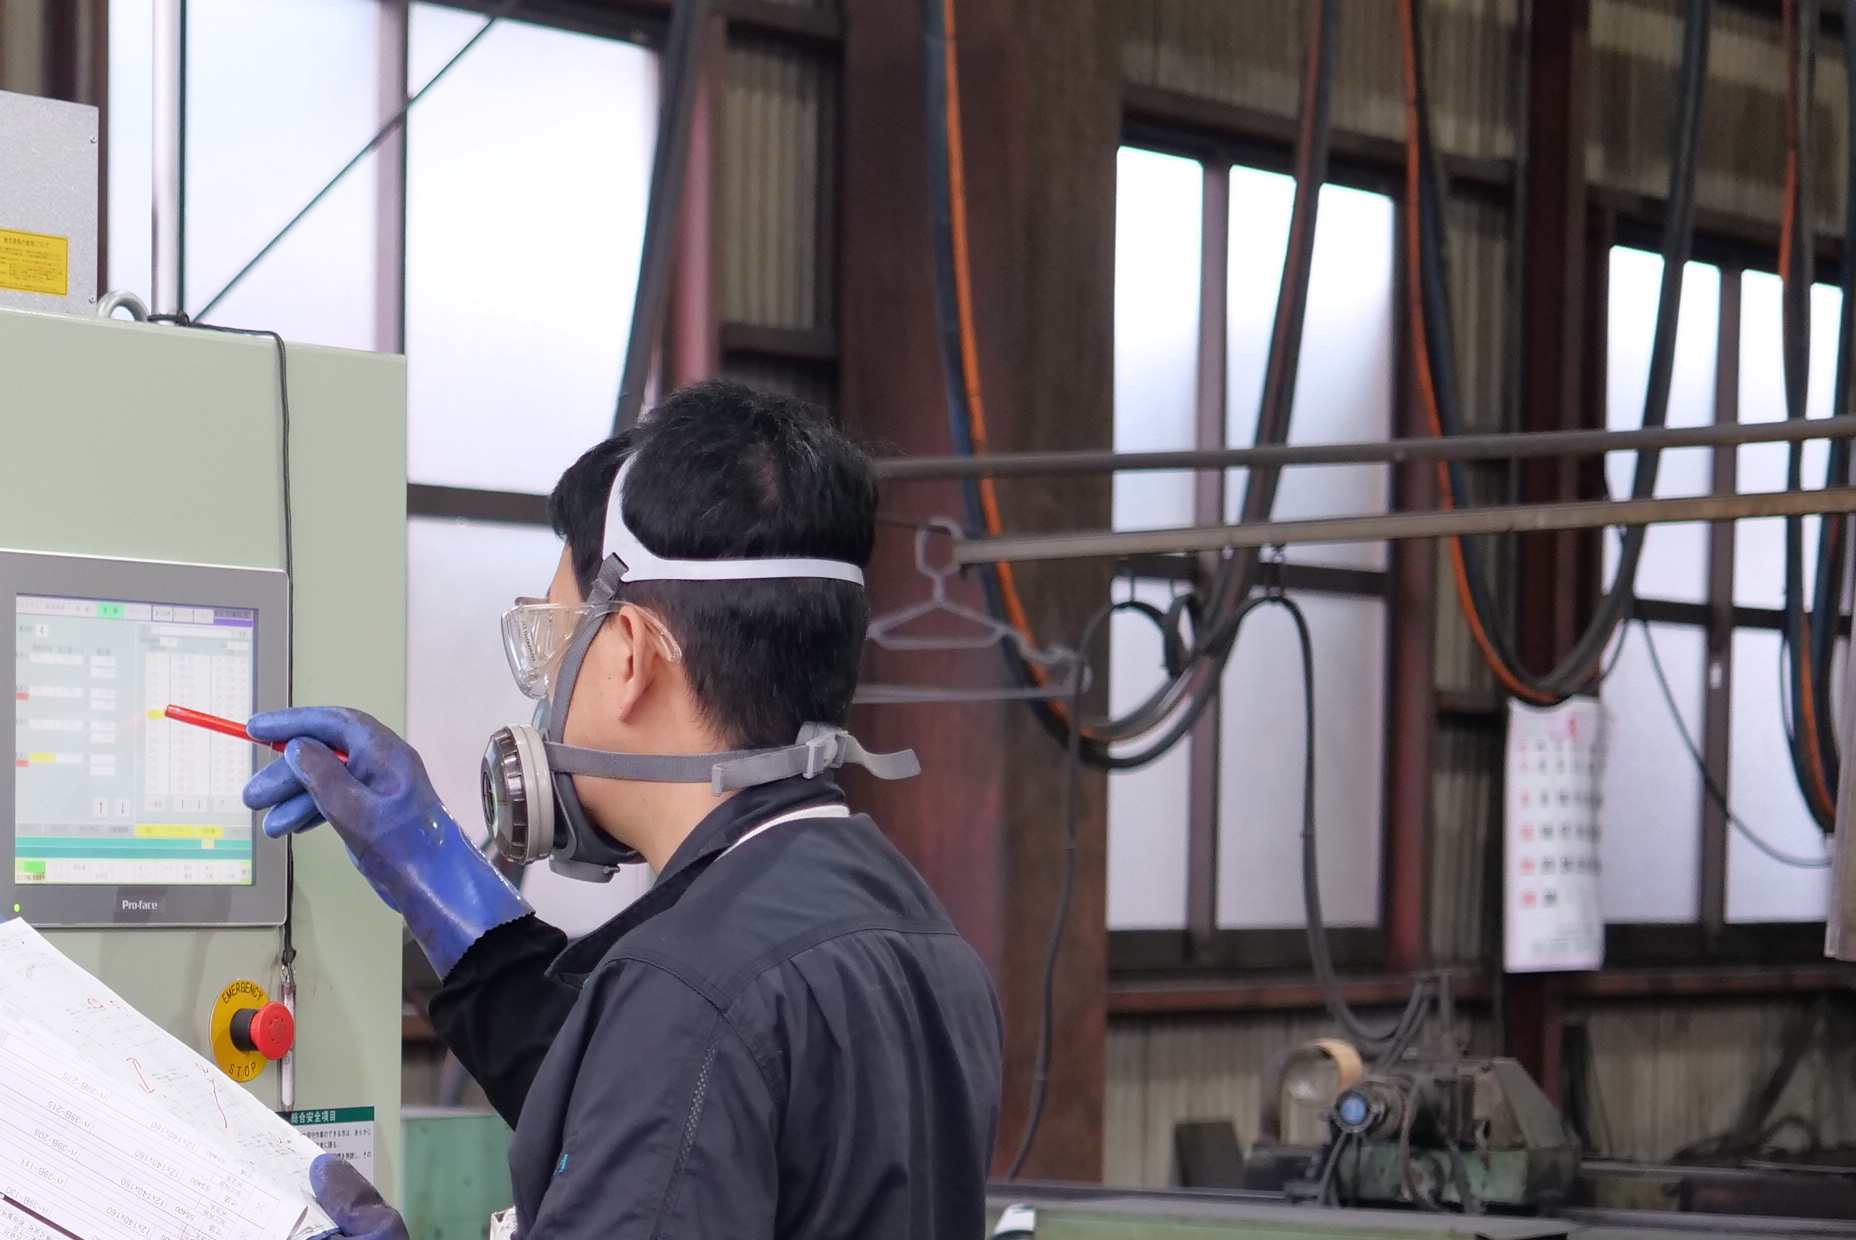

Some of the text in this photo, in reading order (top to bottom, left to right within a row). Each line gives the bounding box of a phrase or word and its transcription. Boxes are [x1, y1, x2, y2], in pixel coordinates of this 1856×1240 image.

[221, 981, 264, 1005] EMERGENCY
[228, 1060, 257, 1077] STOP
[133, 1147, 180, 1179] 12x140x160
[119, 1176, 165, 1207] 12x140x160
[188, 1175, 211, 1192] SS400
[105, 1205, 152, 1236] 12x140x160
[173, 1204, 195, 1221] SS400
